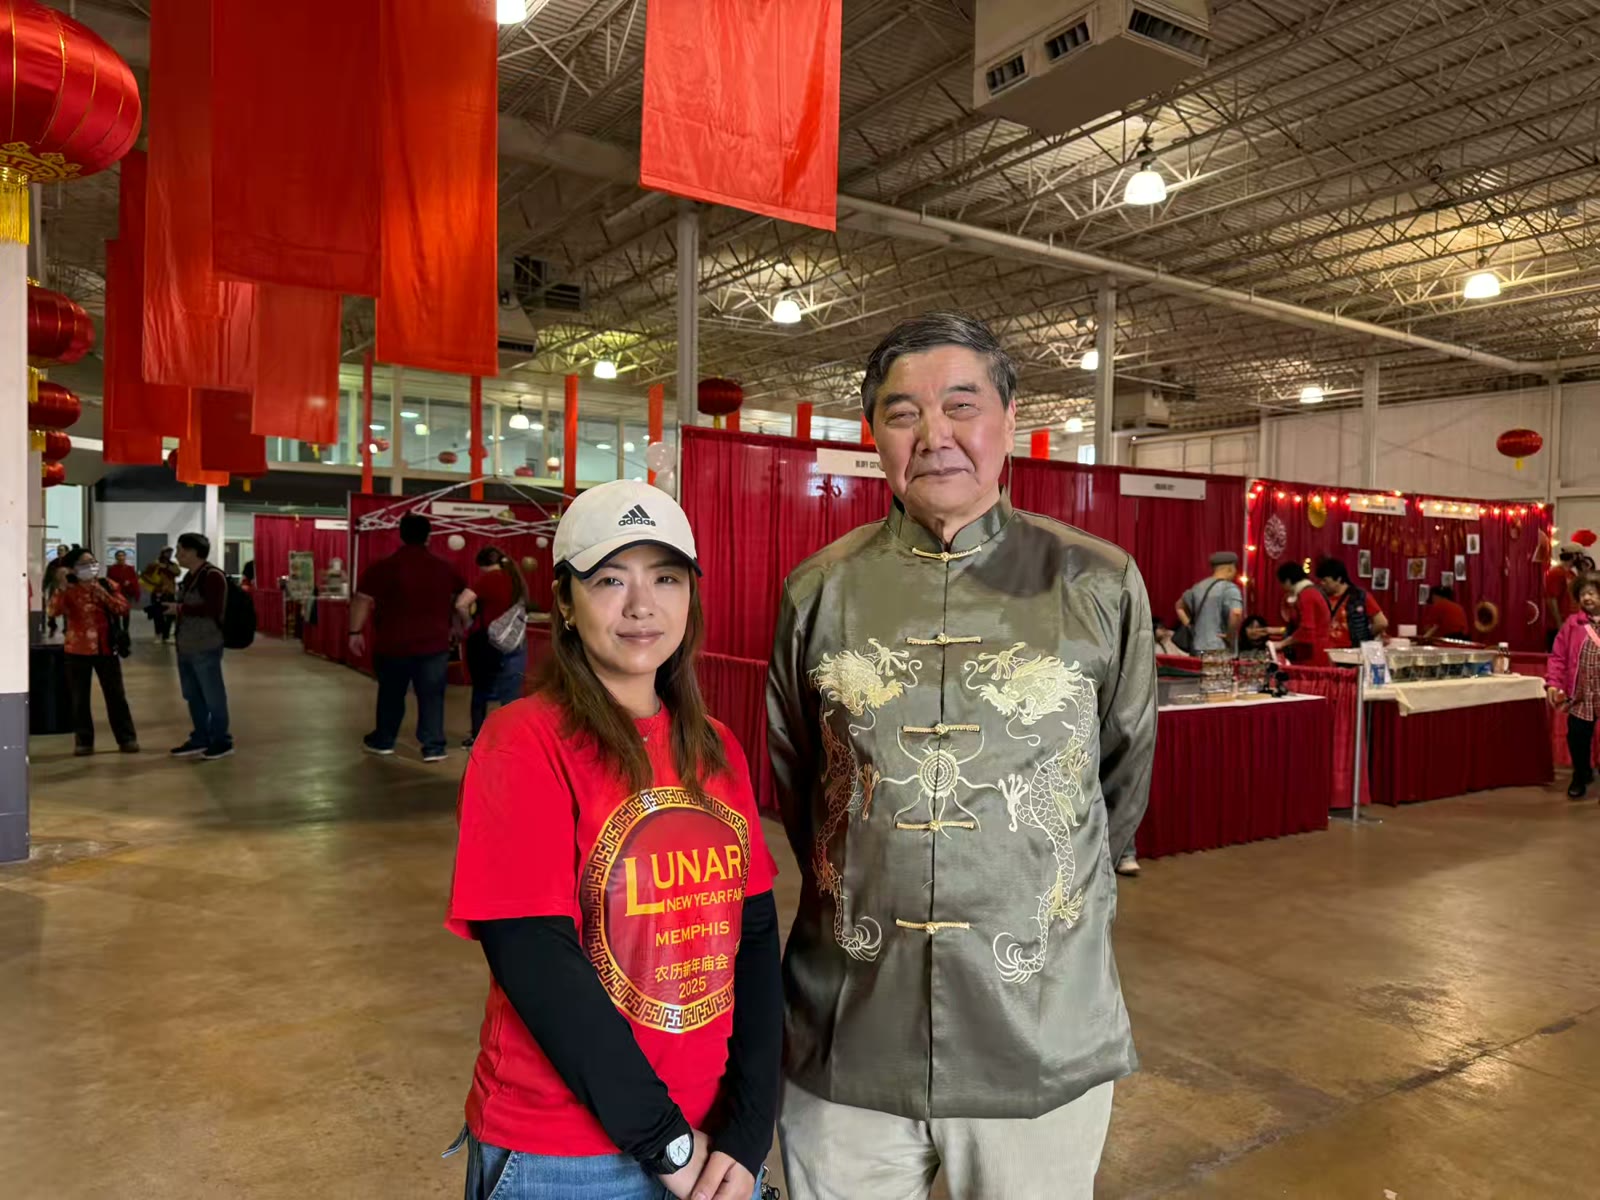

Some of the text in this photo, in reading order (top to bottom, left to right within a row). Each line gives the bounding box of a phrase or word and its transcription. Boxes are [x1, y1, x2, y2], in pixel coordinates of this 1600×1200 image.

[618, 516, 657, 527] adidas
[623, 845, 742, 917] LUNAR
[667, 894, 693, 912] NEW
[694, 890, 726, 907] YEAR
[655, 920, 730, 947] MEMPHIS
[655, 953, 729, 982] 农历新年庙会
[679, 976, 707, 999] 2025
